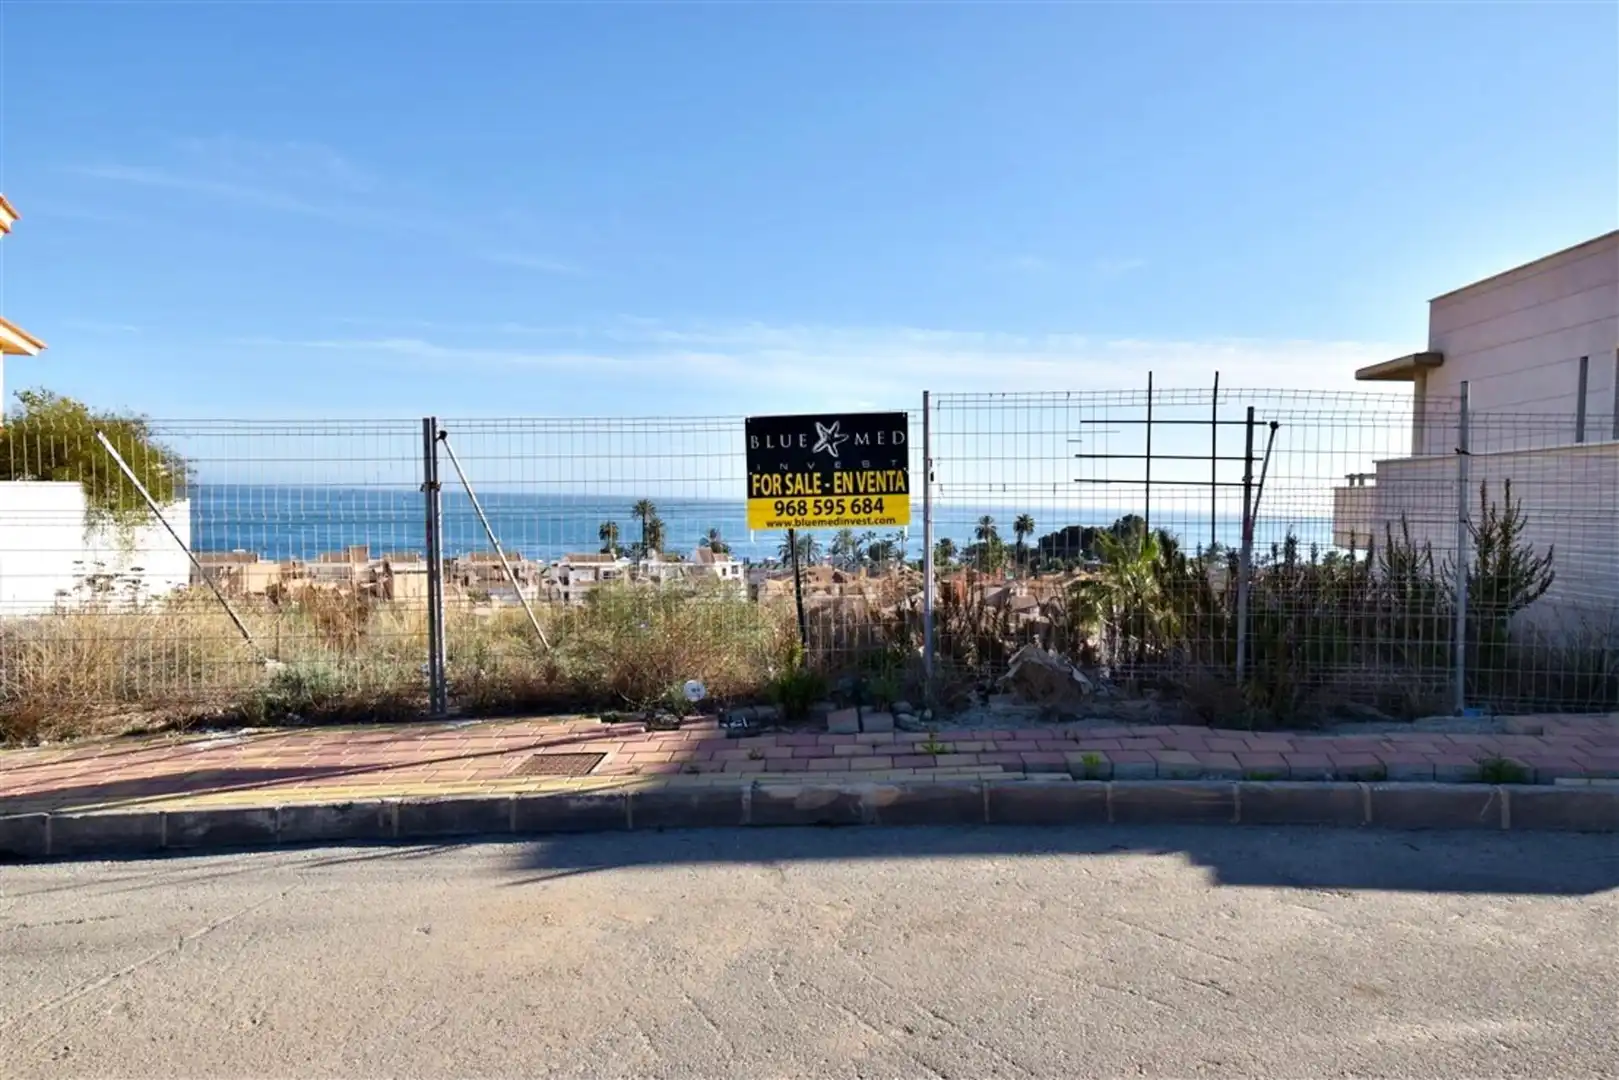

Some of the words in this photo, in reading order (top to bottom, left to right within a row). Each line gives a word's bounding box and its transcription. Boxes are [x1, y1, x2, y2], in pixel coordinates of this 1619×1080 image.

[750, 434, 807, 449] BLUE
[854, 431, 906, 446] MED
[752, 473, 782, 496] FOR
[785, 472, 822, 495] SALE
[834, 471, 853, 494] EN
[856, 470, 906, 493] VENTA
[774, 500, 807, 517] 968
[813, 498, 845, 516] 595
[850, 497, 884, 515] 684
[766, 517, 896, 528] www.bluemedinvest.com
